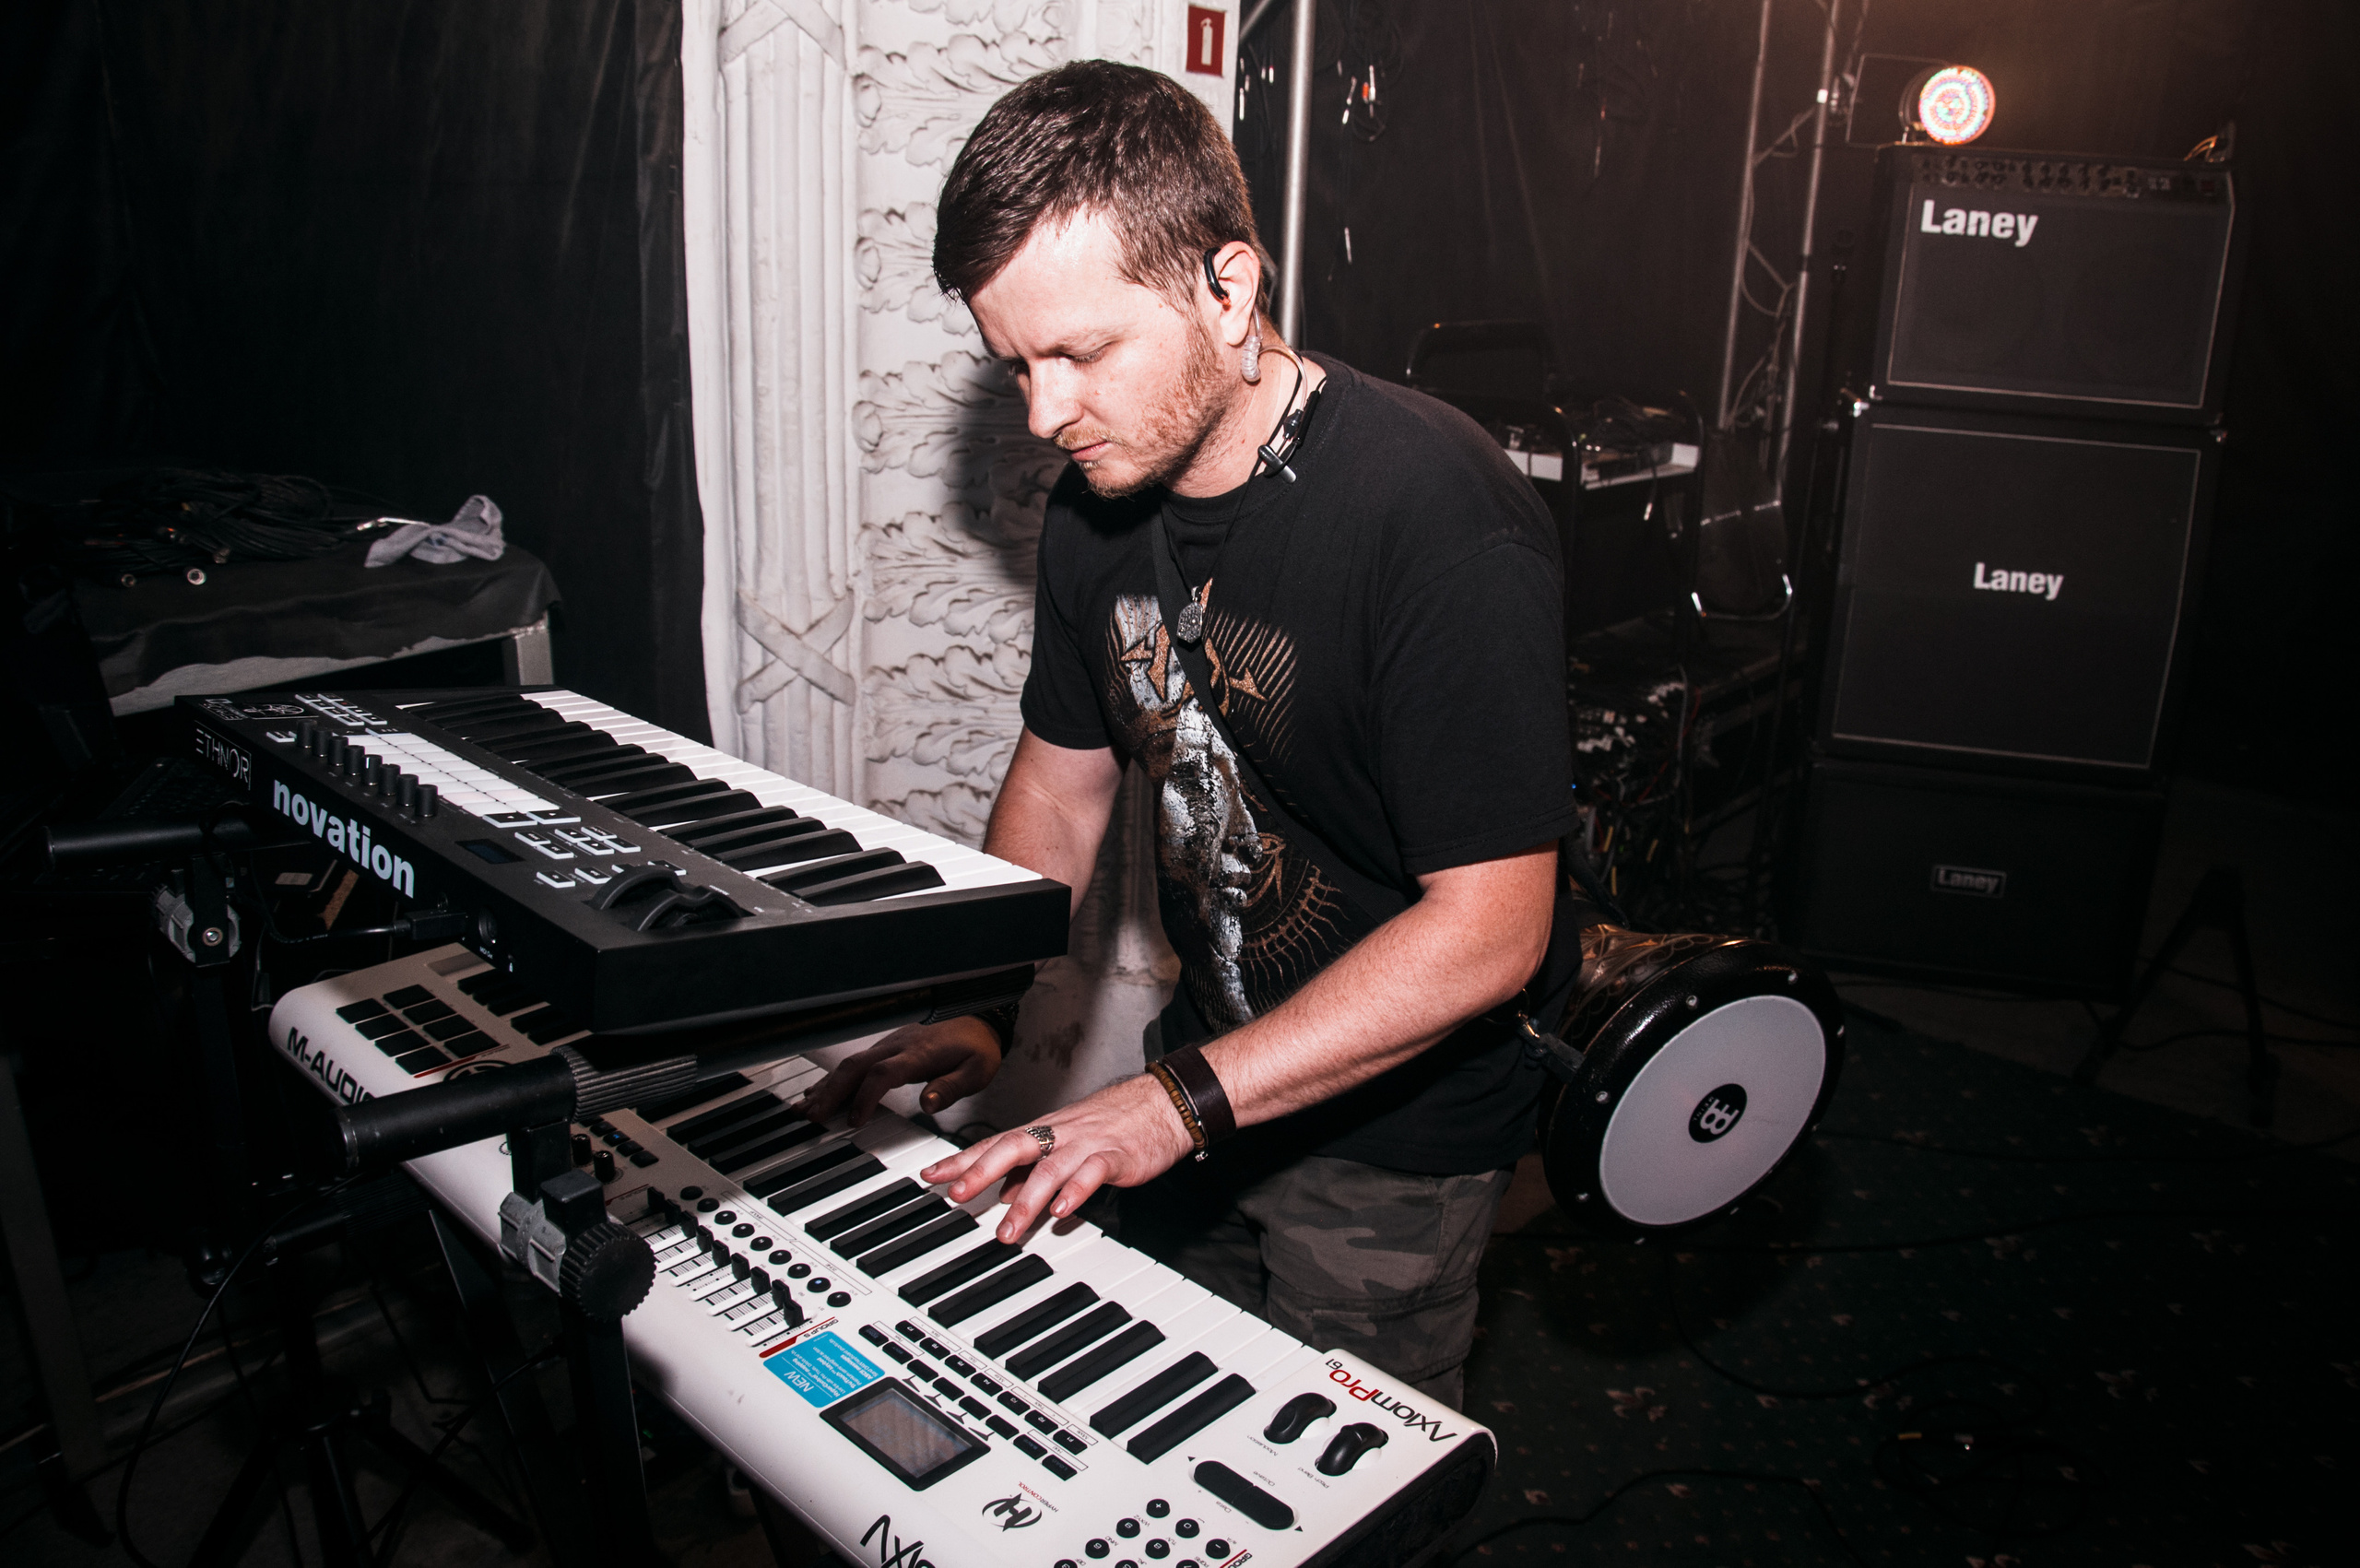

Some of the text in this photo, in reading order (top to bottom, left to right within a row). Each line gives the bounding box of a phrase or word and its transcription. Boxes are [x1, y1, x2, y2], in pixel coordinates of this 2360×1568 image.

[1920, 199, 2038, 247] Laney
[1973, 561, 2064, 602] Laney
[272, 778, 417, 900] novation
[1935, 868, 2000, 895] Laney
[812, 1346, 824, 1355] action
[828, 1338, 845, 1351] shortcuts
[816, 1356, 833, 1370] keybed
[843, 1349, 861, 1363] keyboard
[791, 1357, 810, 1373] mapping
[839, 1353, 873, 1379] ASCII messages
[867, 1368, 878, 1376] Send
[1325, 1358, 1343, 1371] 61
[784, 1371, 814, 1392] NEW
[844, 1371, 862, 1385] Premium
[1246, 1434, 1279, 1456] Modulation
[1253, 1470, 1275, 1487] Octave
[1297, 1467, 1314, 1479] Bend
[1215, 1500, 1233, 1515] Data
